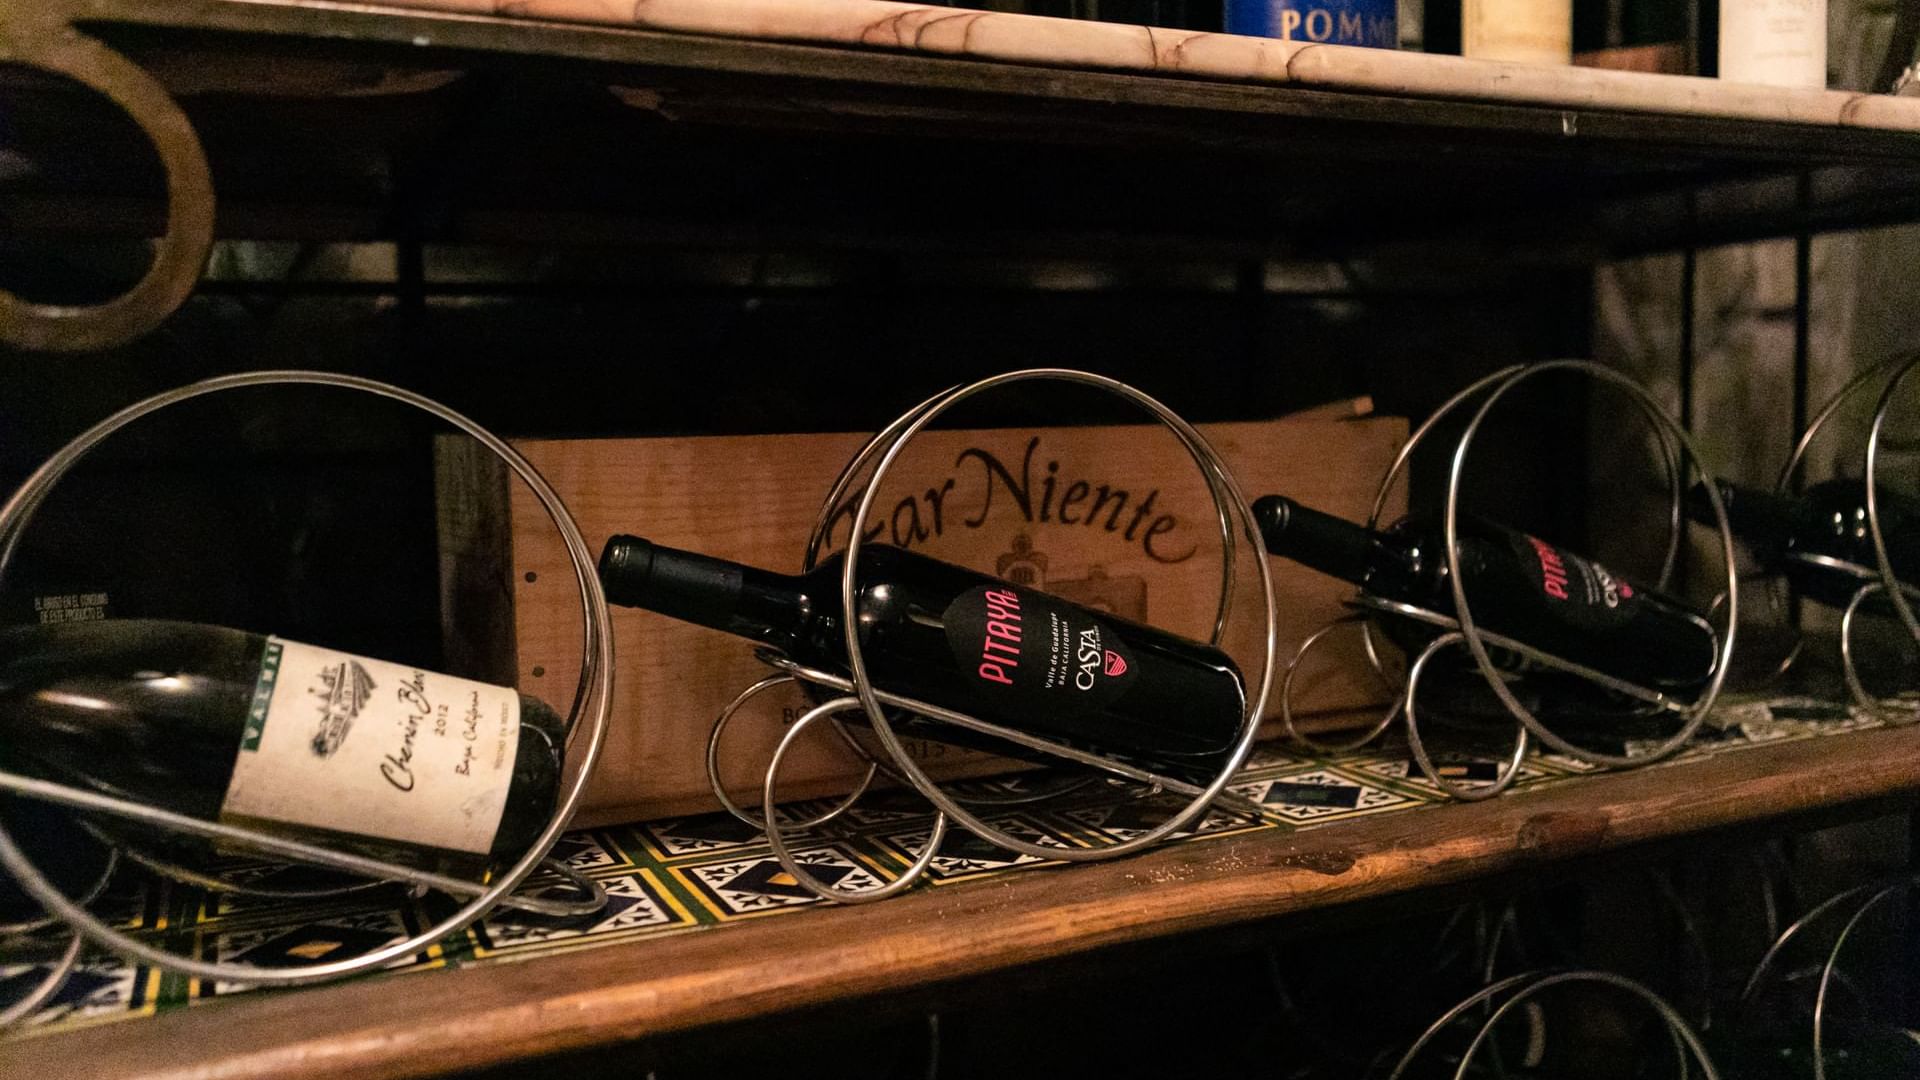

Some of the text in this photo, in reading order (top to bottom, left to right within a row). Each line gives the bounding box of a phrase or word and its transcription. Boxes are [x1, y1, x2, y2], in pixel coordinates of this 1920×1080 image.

[956, 436, 1197, 564] Niente
[977, 589, 1022, 686] PITAYA
[1045, 611, 1060, 689] Valle de Guadalupe
[1058, 620, 1071, 686] BAJA CALIFORNIA
[1075, 629, 1101, 691] CASTA
[381, 670, 431, 792] Chenin Blan
[434, 704, 449, 737] 2012
